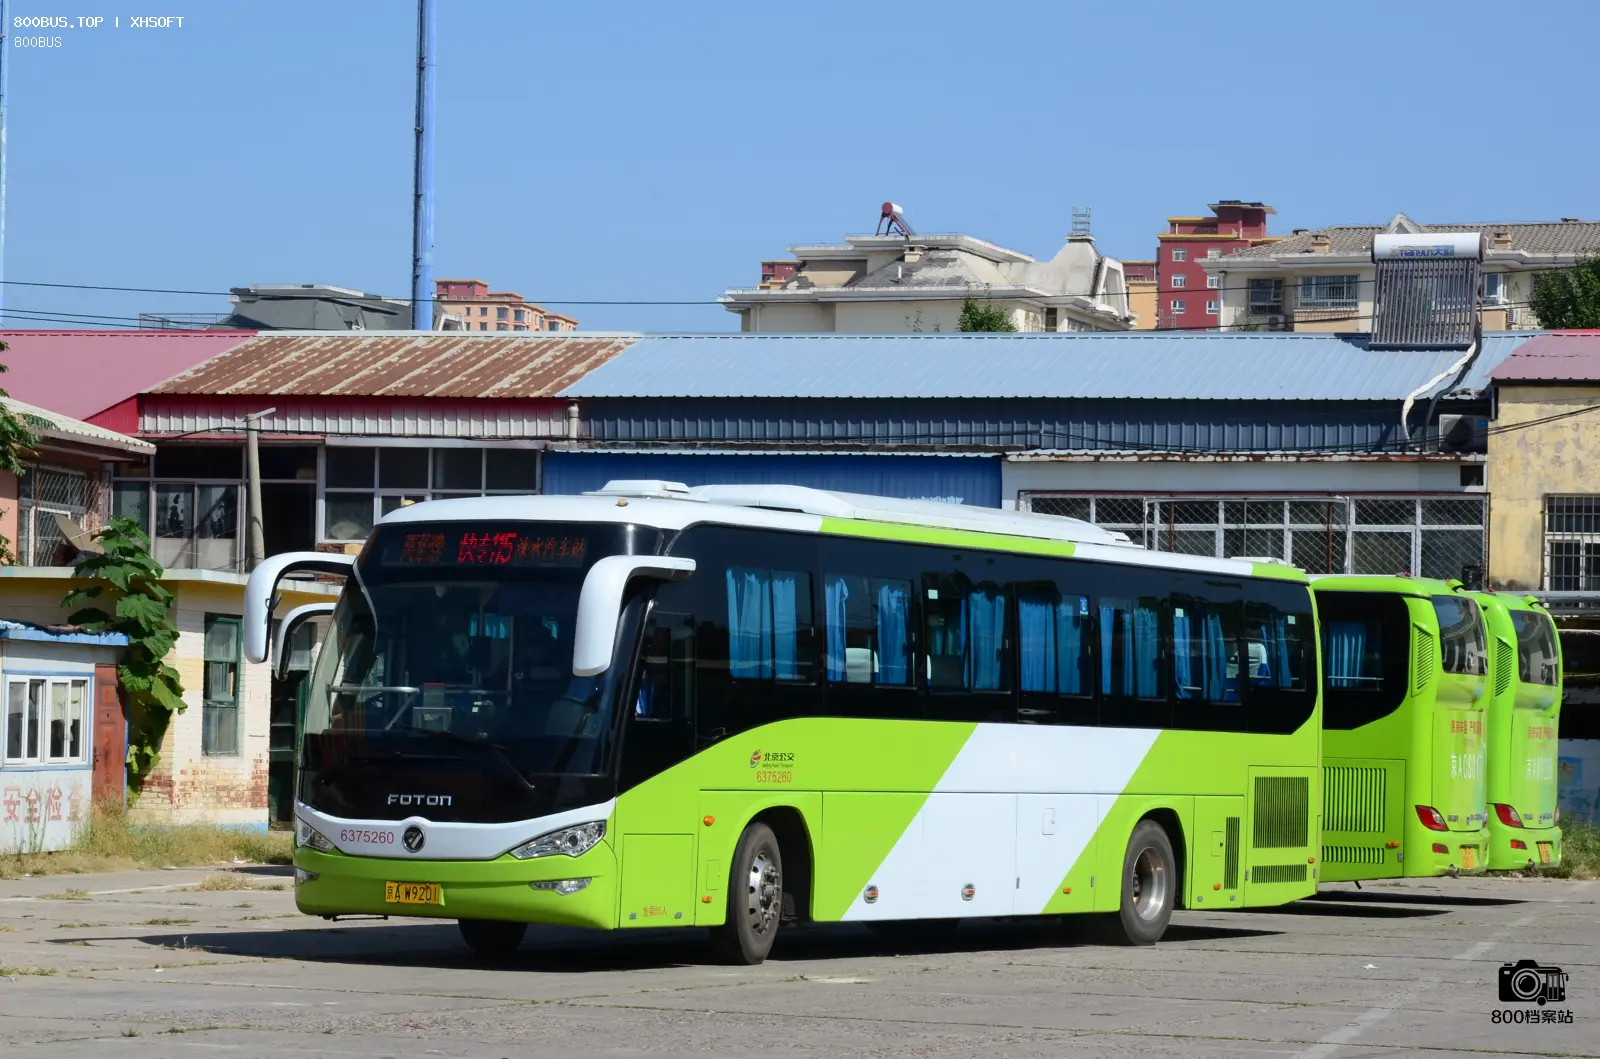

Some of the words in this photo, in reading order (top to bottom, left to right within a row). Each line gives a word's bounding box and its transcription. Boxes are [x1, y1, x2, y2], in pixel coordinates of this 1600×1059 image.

[763, 752, 795, 761] 北京公交
[756, 770, 792, 783] 6375260
[387, 793, 452, 806] FOTON
[340, 828, 394, 845] 6375260
